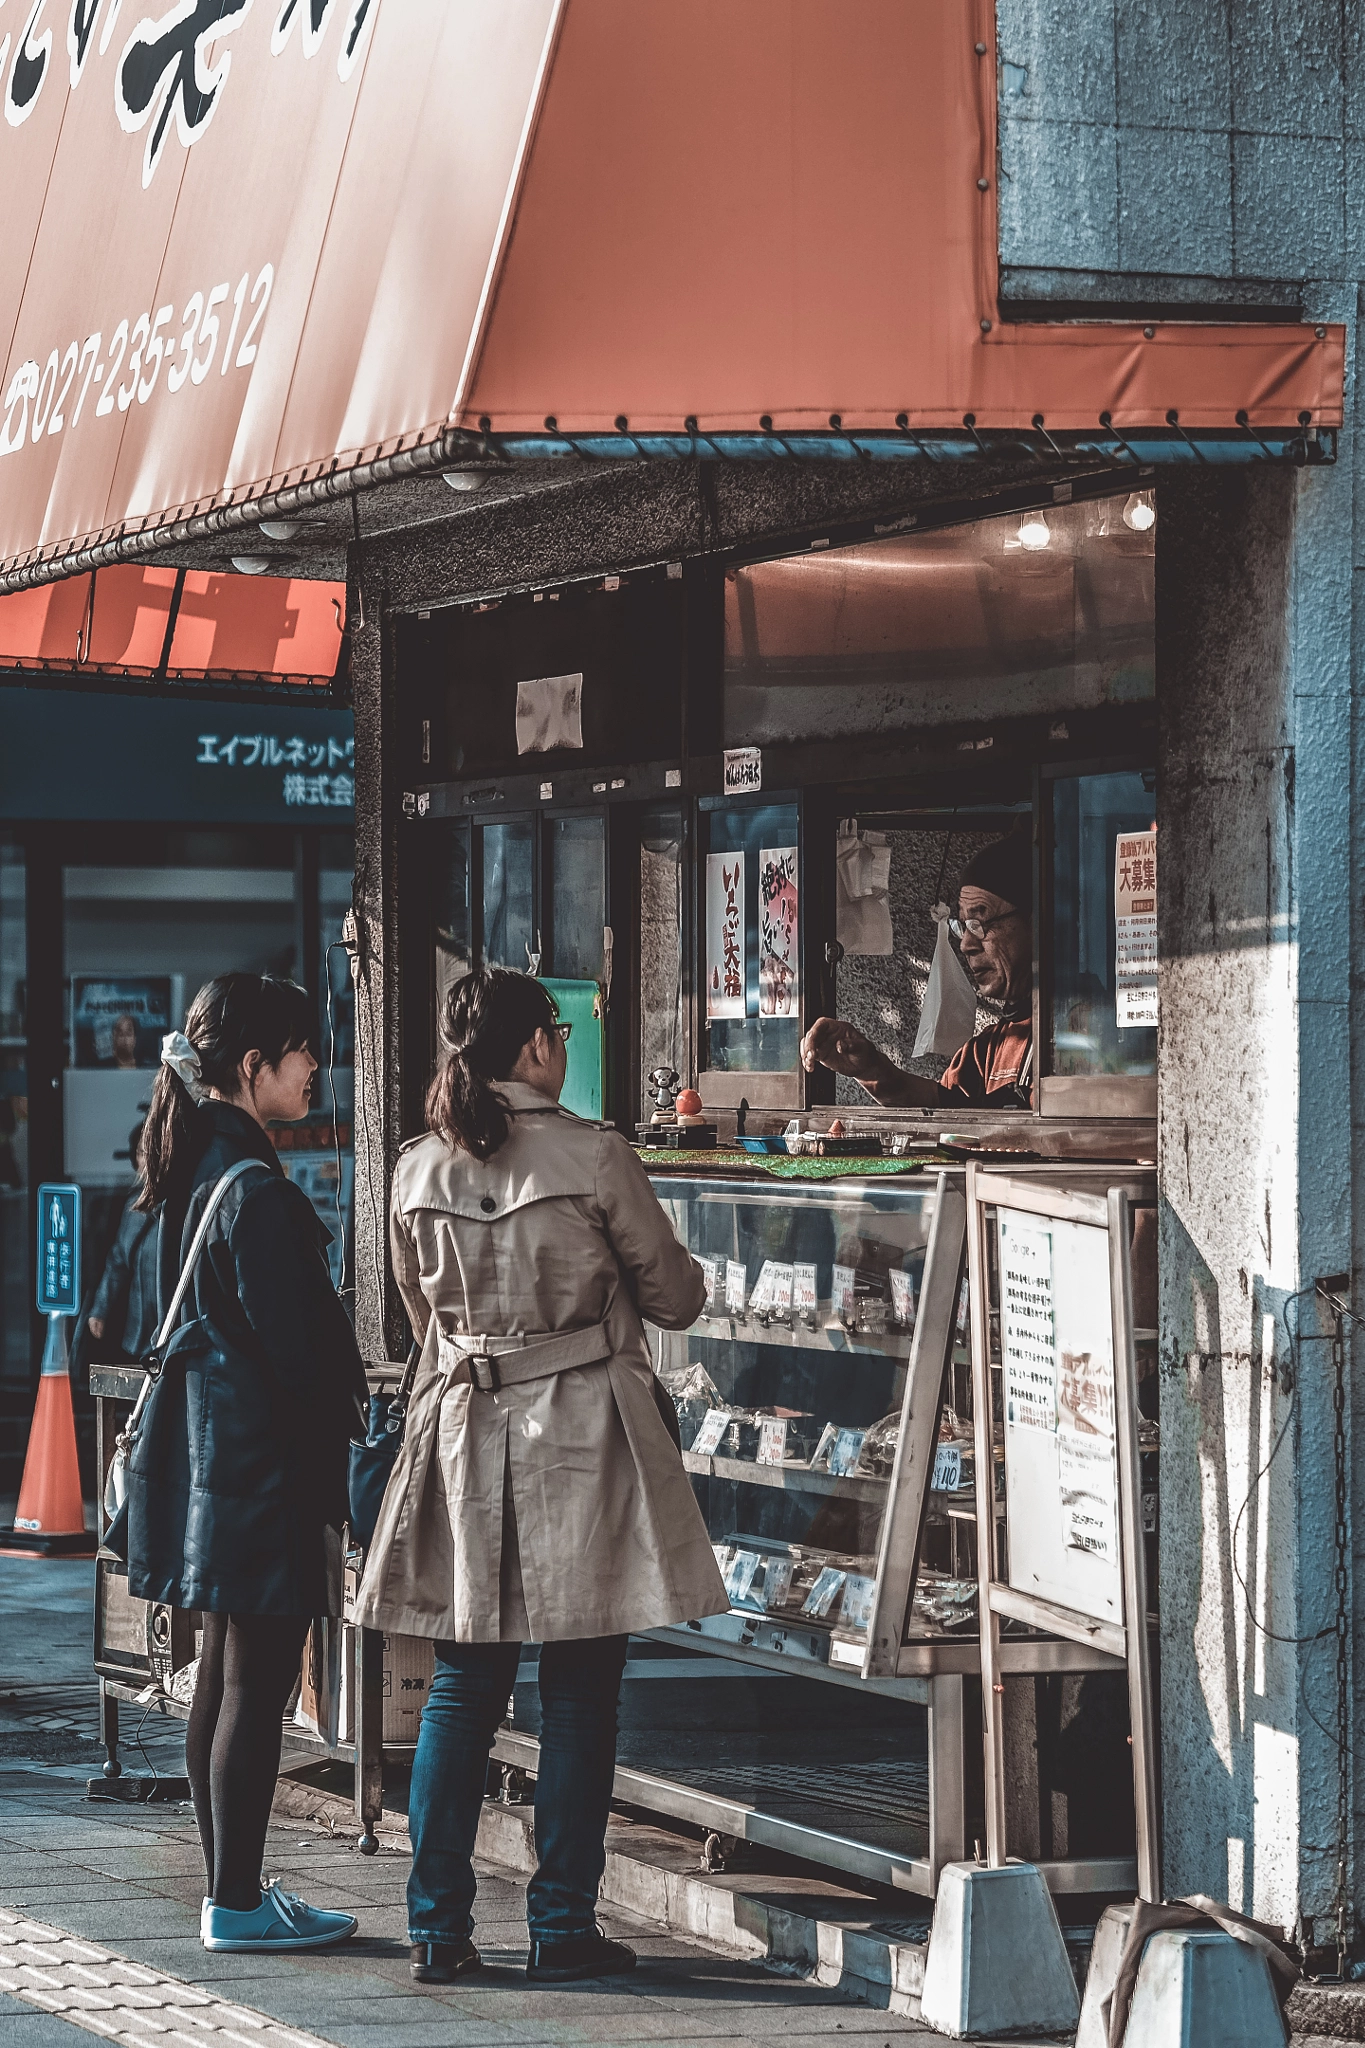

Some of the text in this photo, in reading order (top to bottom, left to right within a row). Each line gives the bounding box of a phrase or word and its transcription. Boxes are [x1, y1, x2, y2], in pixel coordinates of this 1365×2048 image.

[30, 263, 273, 443] 027-235-3512
[1119, 858, 1155, 893] 大募集
[401, 1678, 425, 1691] 冷凍
